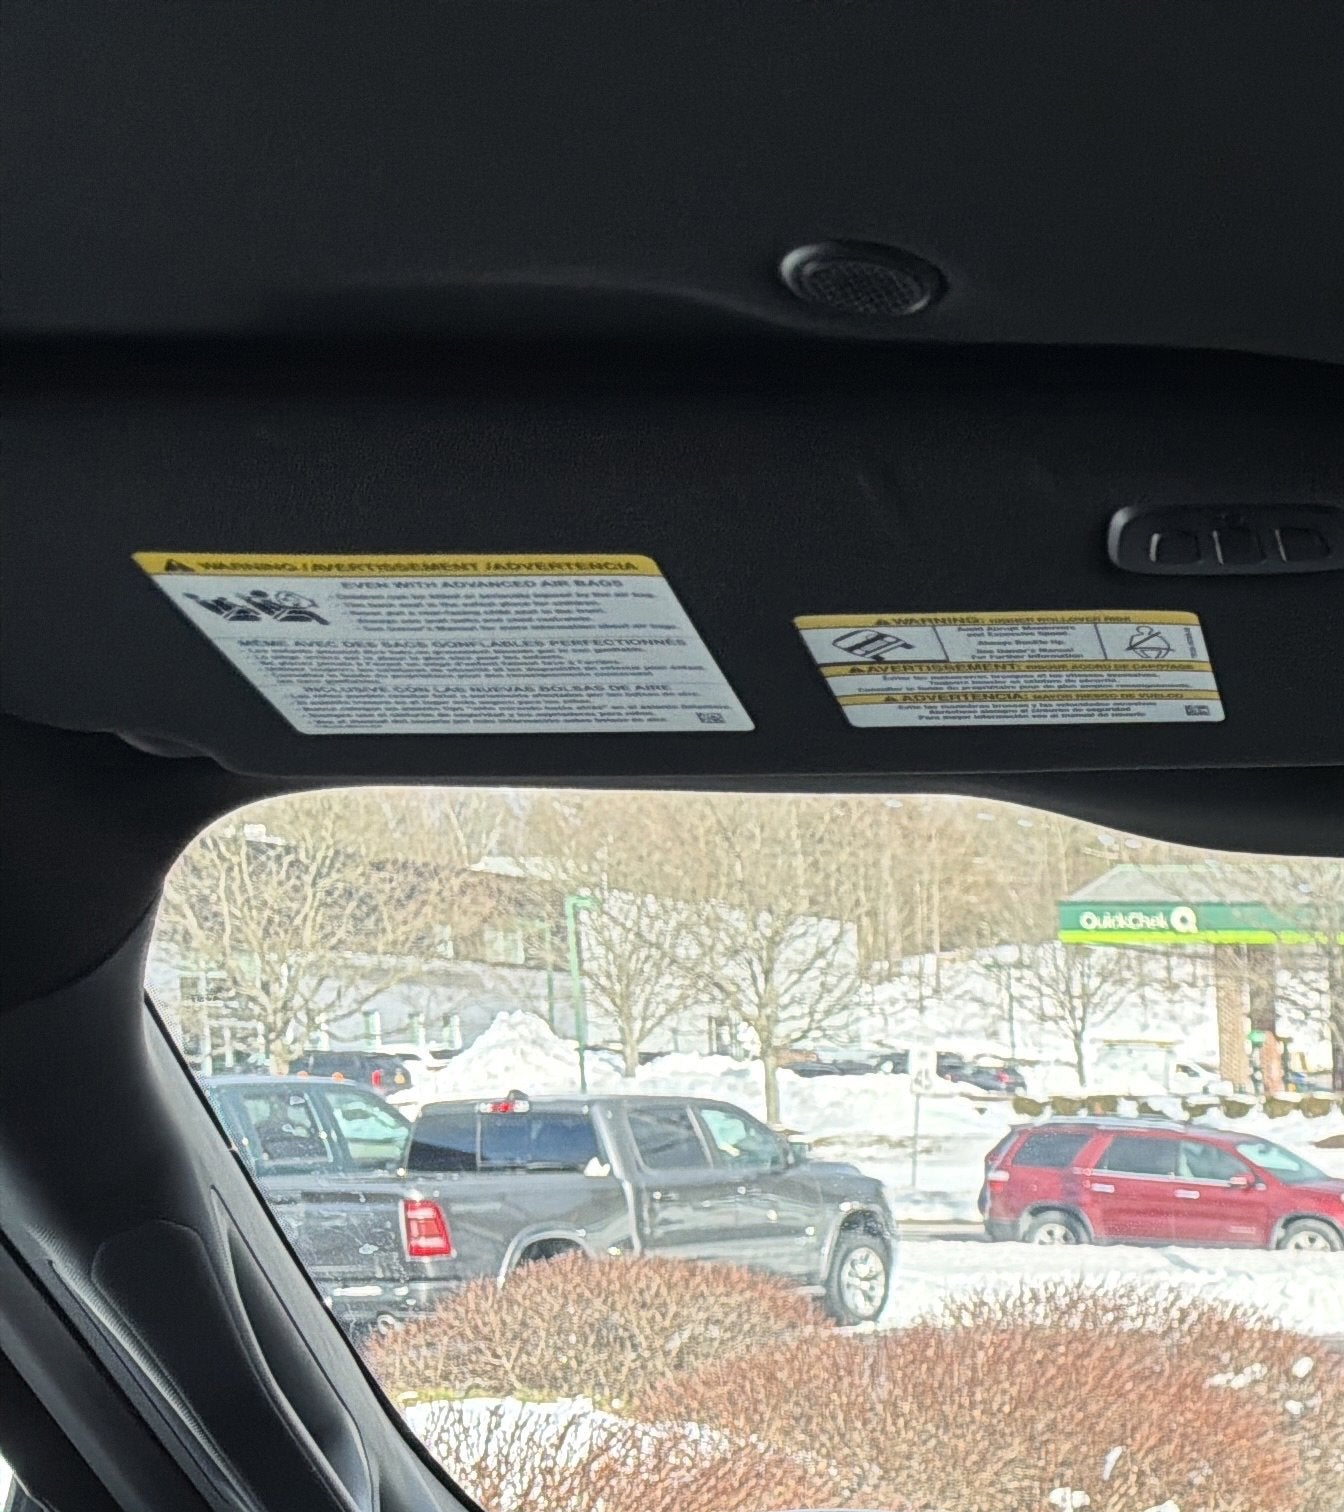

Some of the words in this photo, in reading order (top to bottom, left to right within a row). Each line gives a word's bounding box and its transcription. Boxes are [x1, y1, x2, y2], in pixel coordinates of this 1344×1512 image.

[440, 580, 536, 589] ADVANCED
[540, 579, 569, 588] AIR
[574, 579, 624, 588] BAGS
